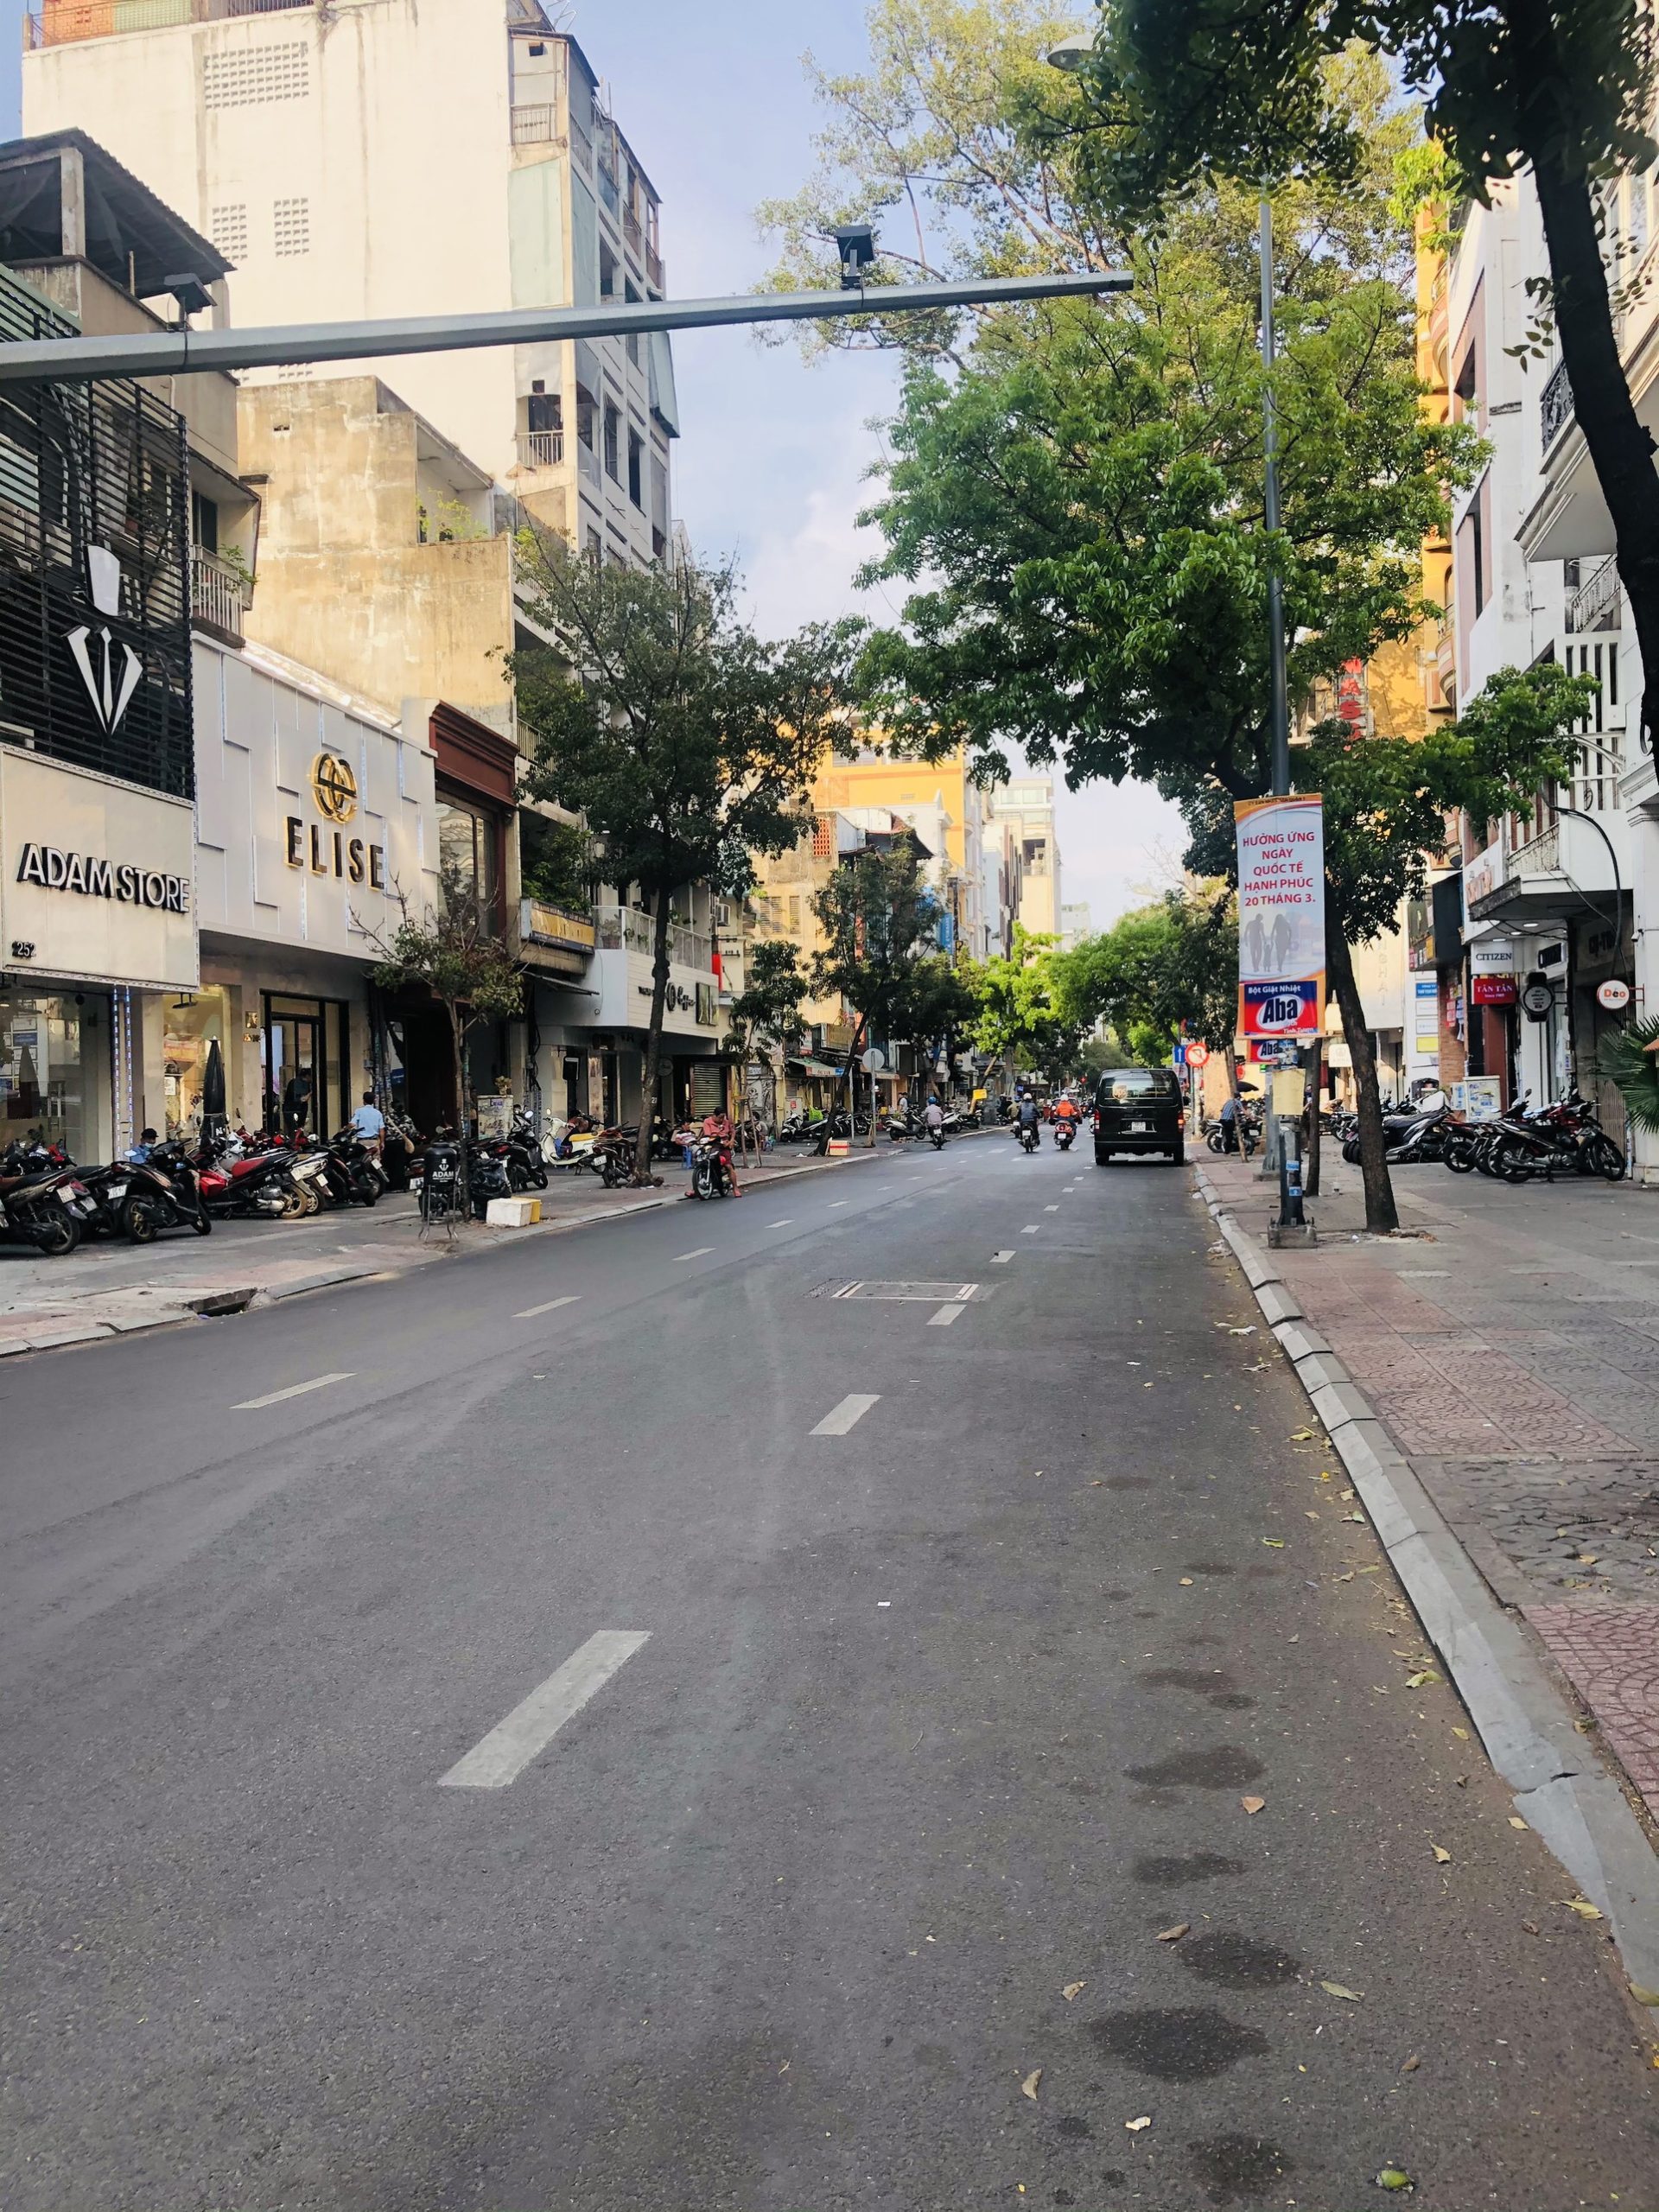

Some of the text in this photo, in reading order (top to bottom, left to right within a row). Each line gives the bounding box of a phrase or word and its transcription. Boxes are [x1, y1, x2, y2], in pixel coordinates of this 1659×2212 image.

[1287, 831, 1315, 843] ỨNG
[284, 816, 385, 890] ELISE
[1262, 846, 1294, 860] NGÀY
[1253, 860, 1304, 877] QUỐC TẾ
[17, 843, 190, 913] ADAM STORE
[1244, 876, 1314, 893] HẠNH PHÚC
[1245, 892, 1317, 906] 20 THÁNG 3.
[13, 940, 37, 958] 252
[1475, 952, 1513, 962] CITIZEN
[1248, 984, 1301, 995] Bột Giặt Nhiệt
[1262, 997, 1299, 1025] Aba
